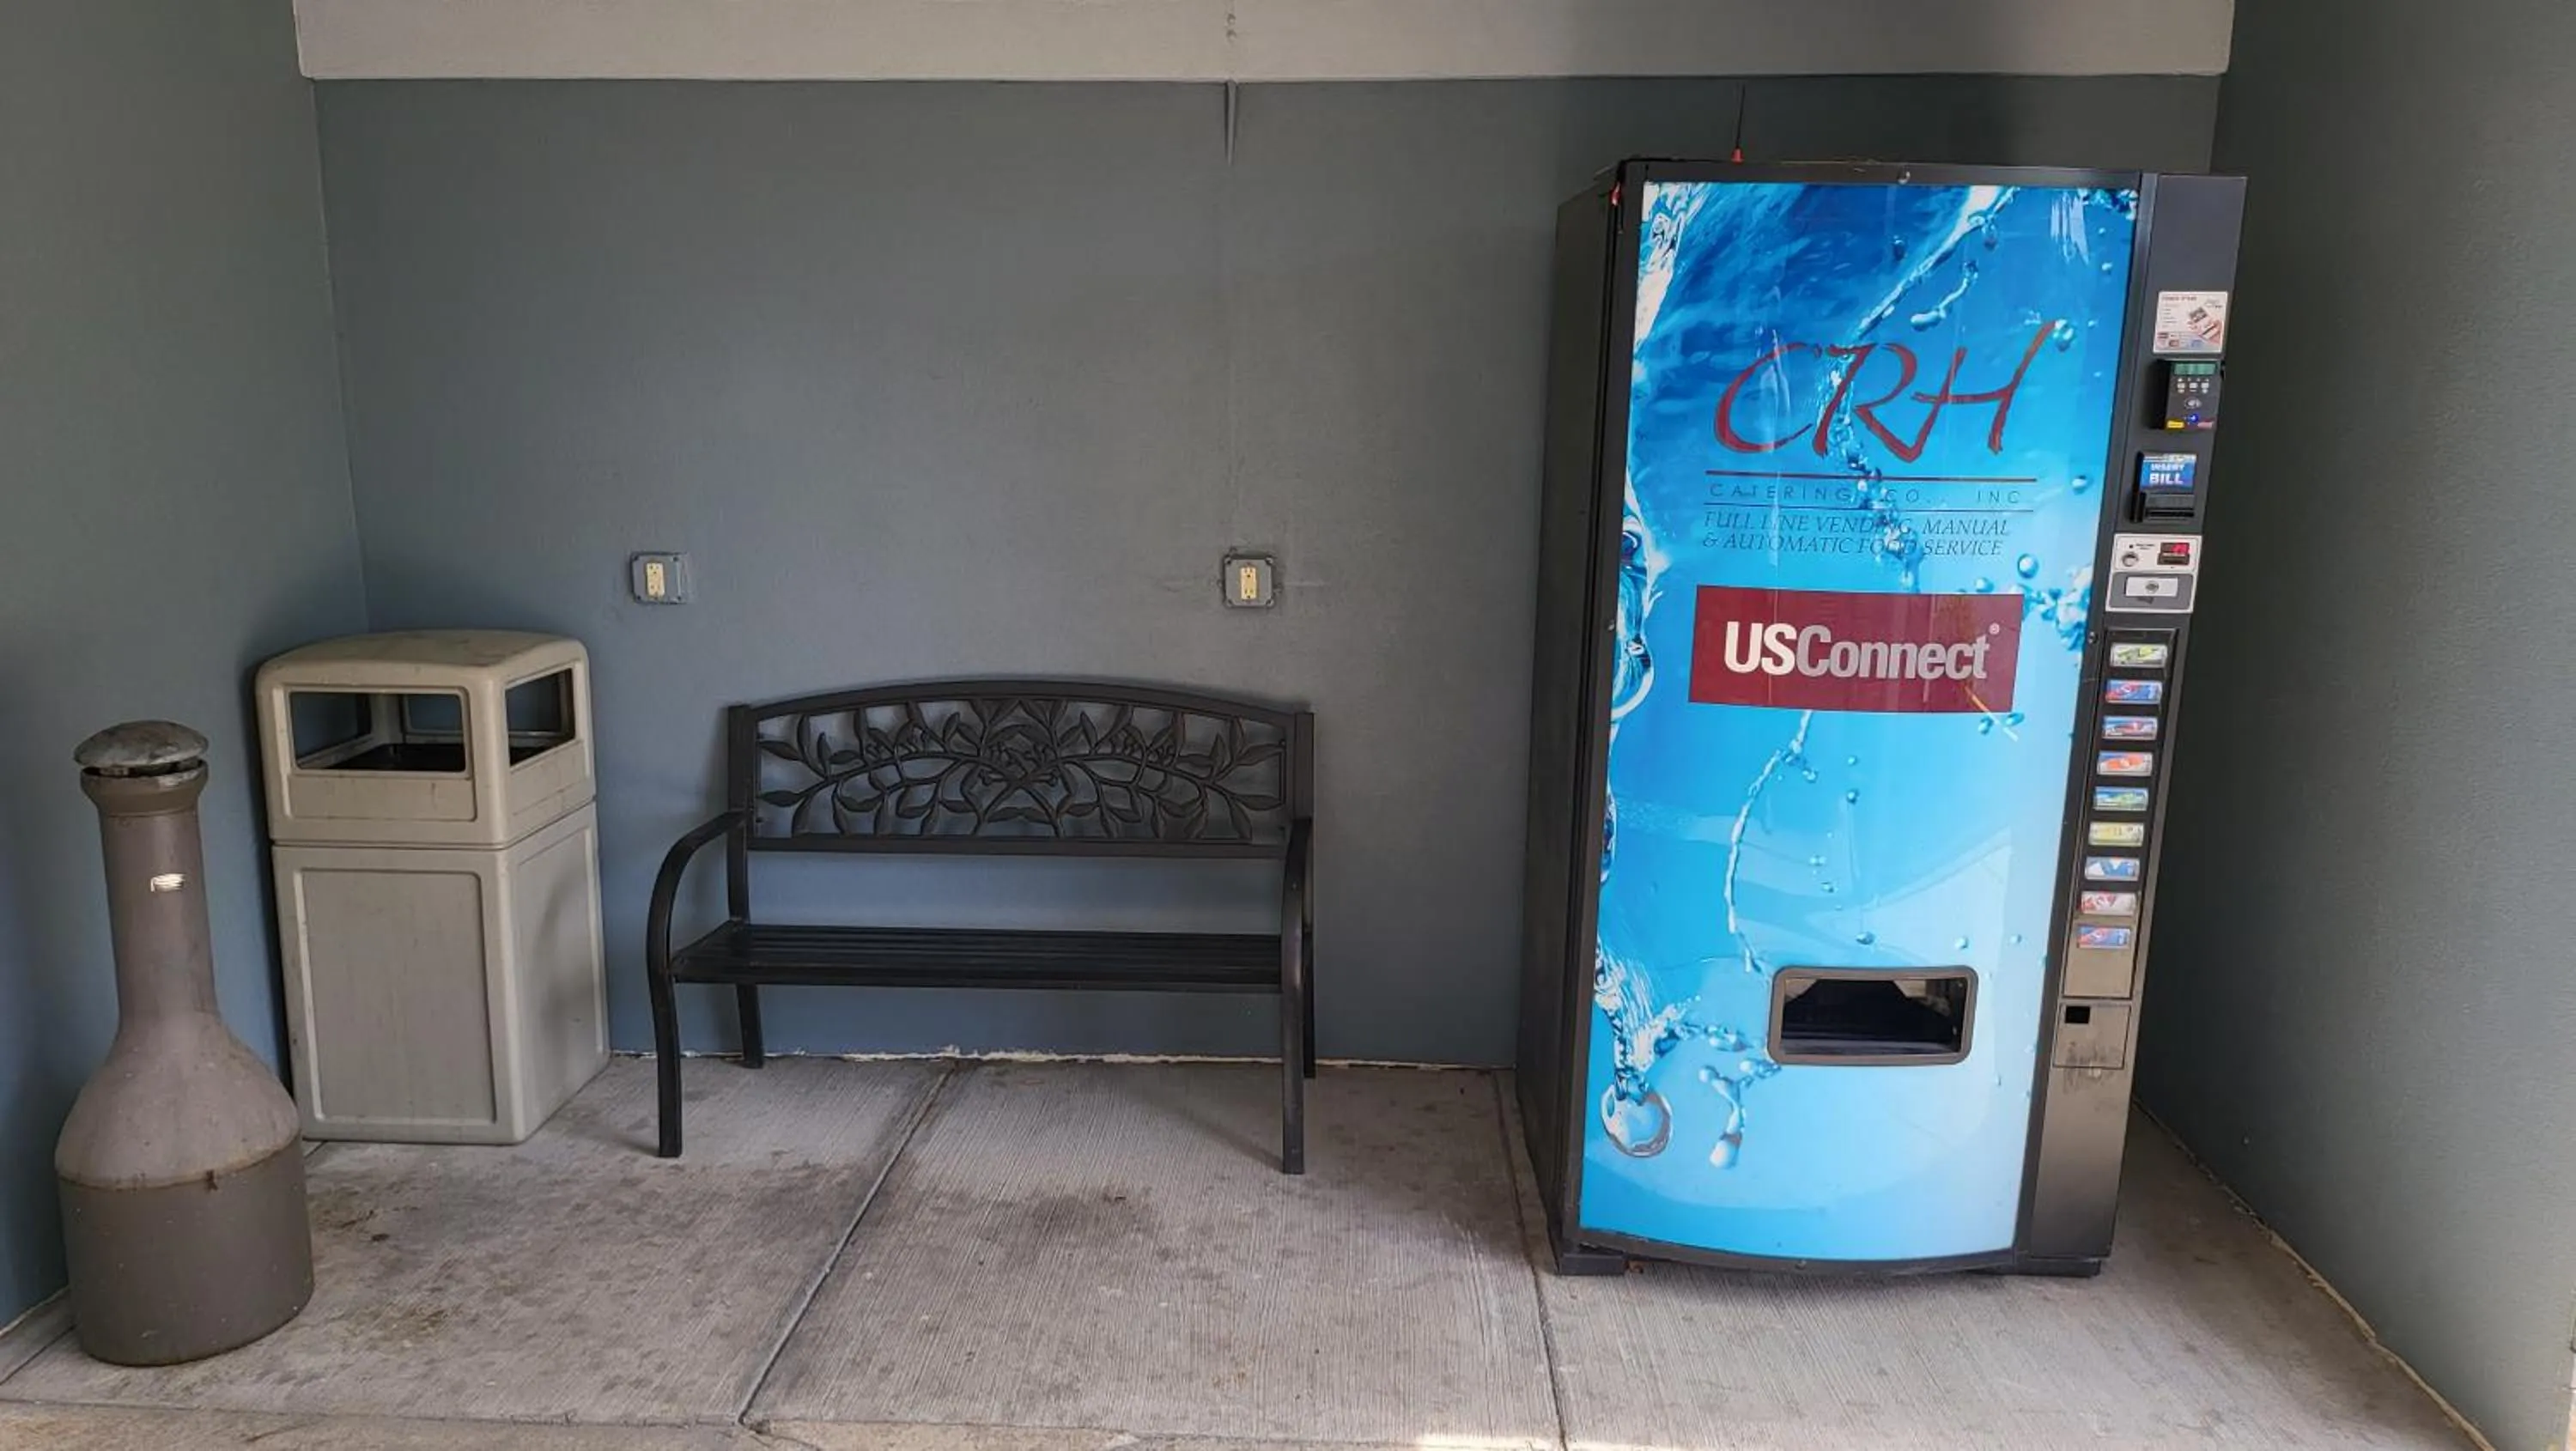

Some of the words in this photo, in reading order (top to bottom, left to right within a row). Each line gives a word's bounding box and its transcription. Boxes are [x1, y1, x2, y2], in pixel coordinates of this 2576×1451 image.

[1714, 319, 2056, 464] CRH
[2149, 472, 2184, 486] BILL
[1709, 483, 1852, 501] CATERING
[1977, 490, 2020, 504] INC
[1704, 511, 1753, 531] FULL
[1923, 518, 2010, 537] MANUAL
[1702, 531, 1718, 548] &
[1722, 533, 1854, 555] AUTOMATIC
[1856, 537, 1917, 556] FOOD
[1922, 538, 2003, 556] SERVICE
